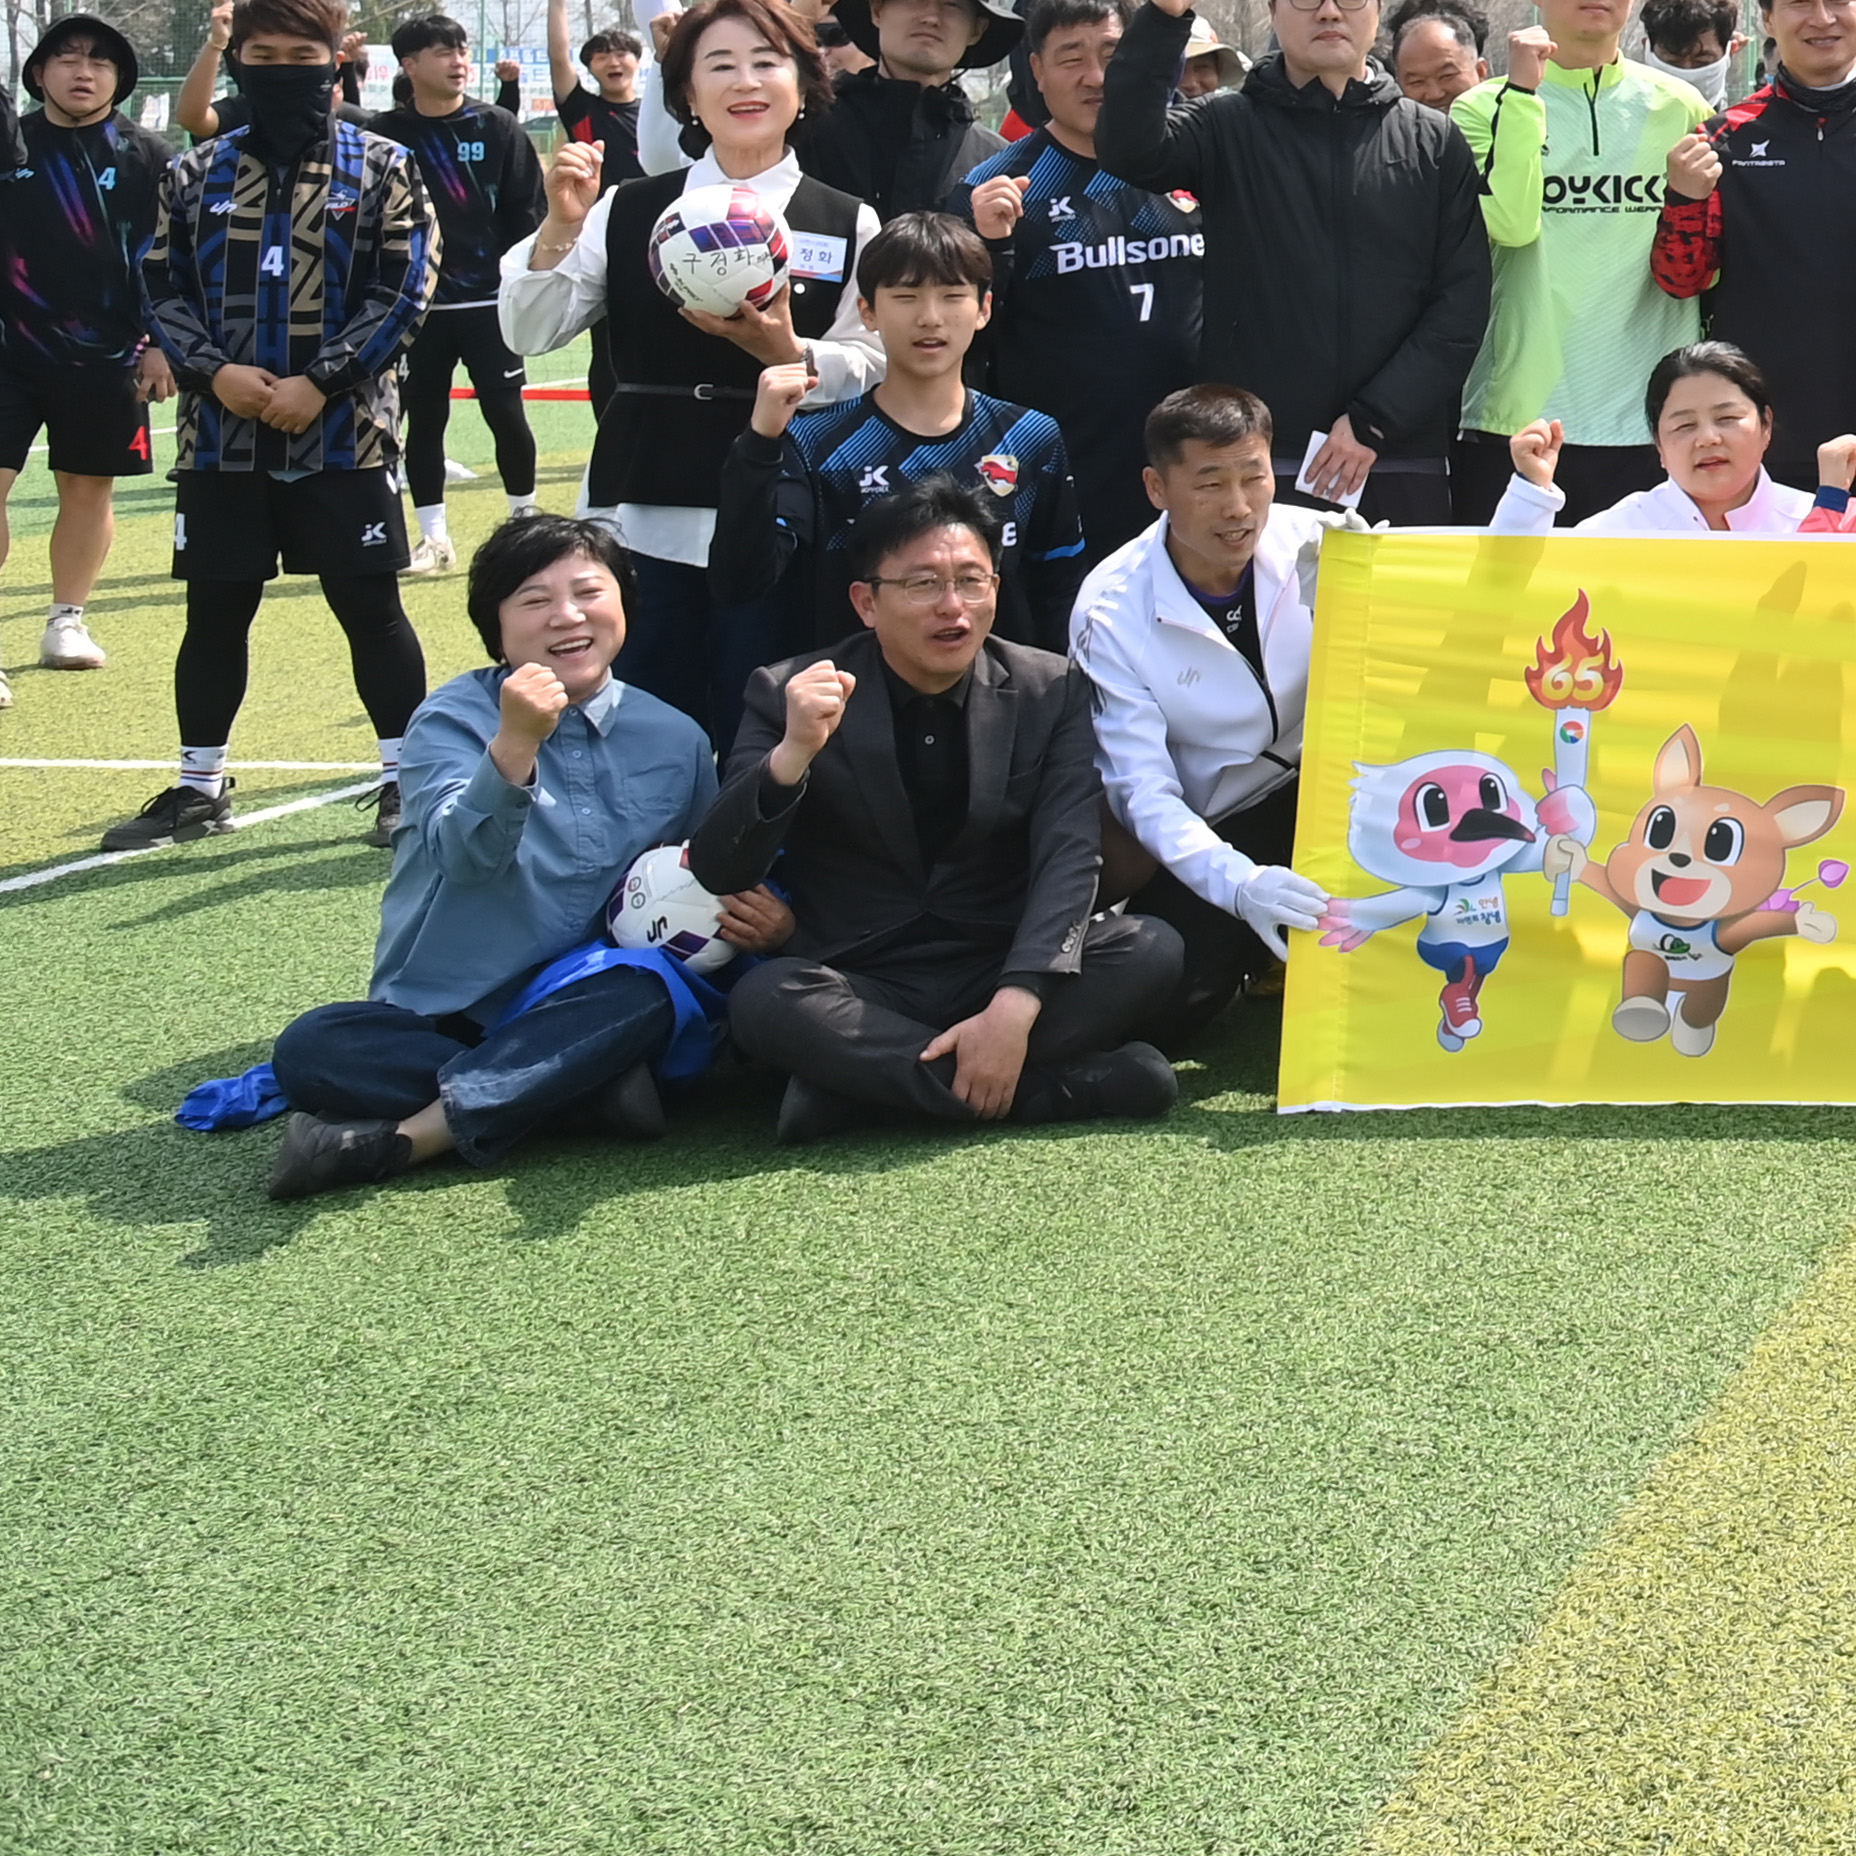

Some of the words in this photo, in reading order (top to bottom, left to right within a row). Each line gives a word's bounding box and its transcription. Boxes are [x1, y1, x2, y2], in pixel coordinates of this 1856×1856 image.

[457, 141, 484, 162] 99
[98, 166, 116, 191] 4
[1543, 175, 1663, 204] OYKICK
[261, 246, 284, 277] 4
[800, 247, 832, 264] 정화
[1049, 233, 1205, 274] Bullsone
[1130, 283, 1154, 322] 7
[128, 425, 149, 461] 4
[1541, 652, 1605, 701] 65
